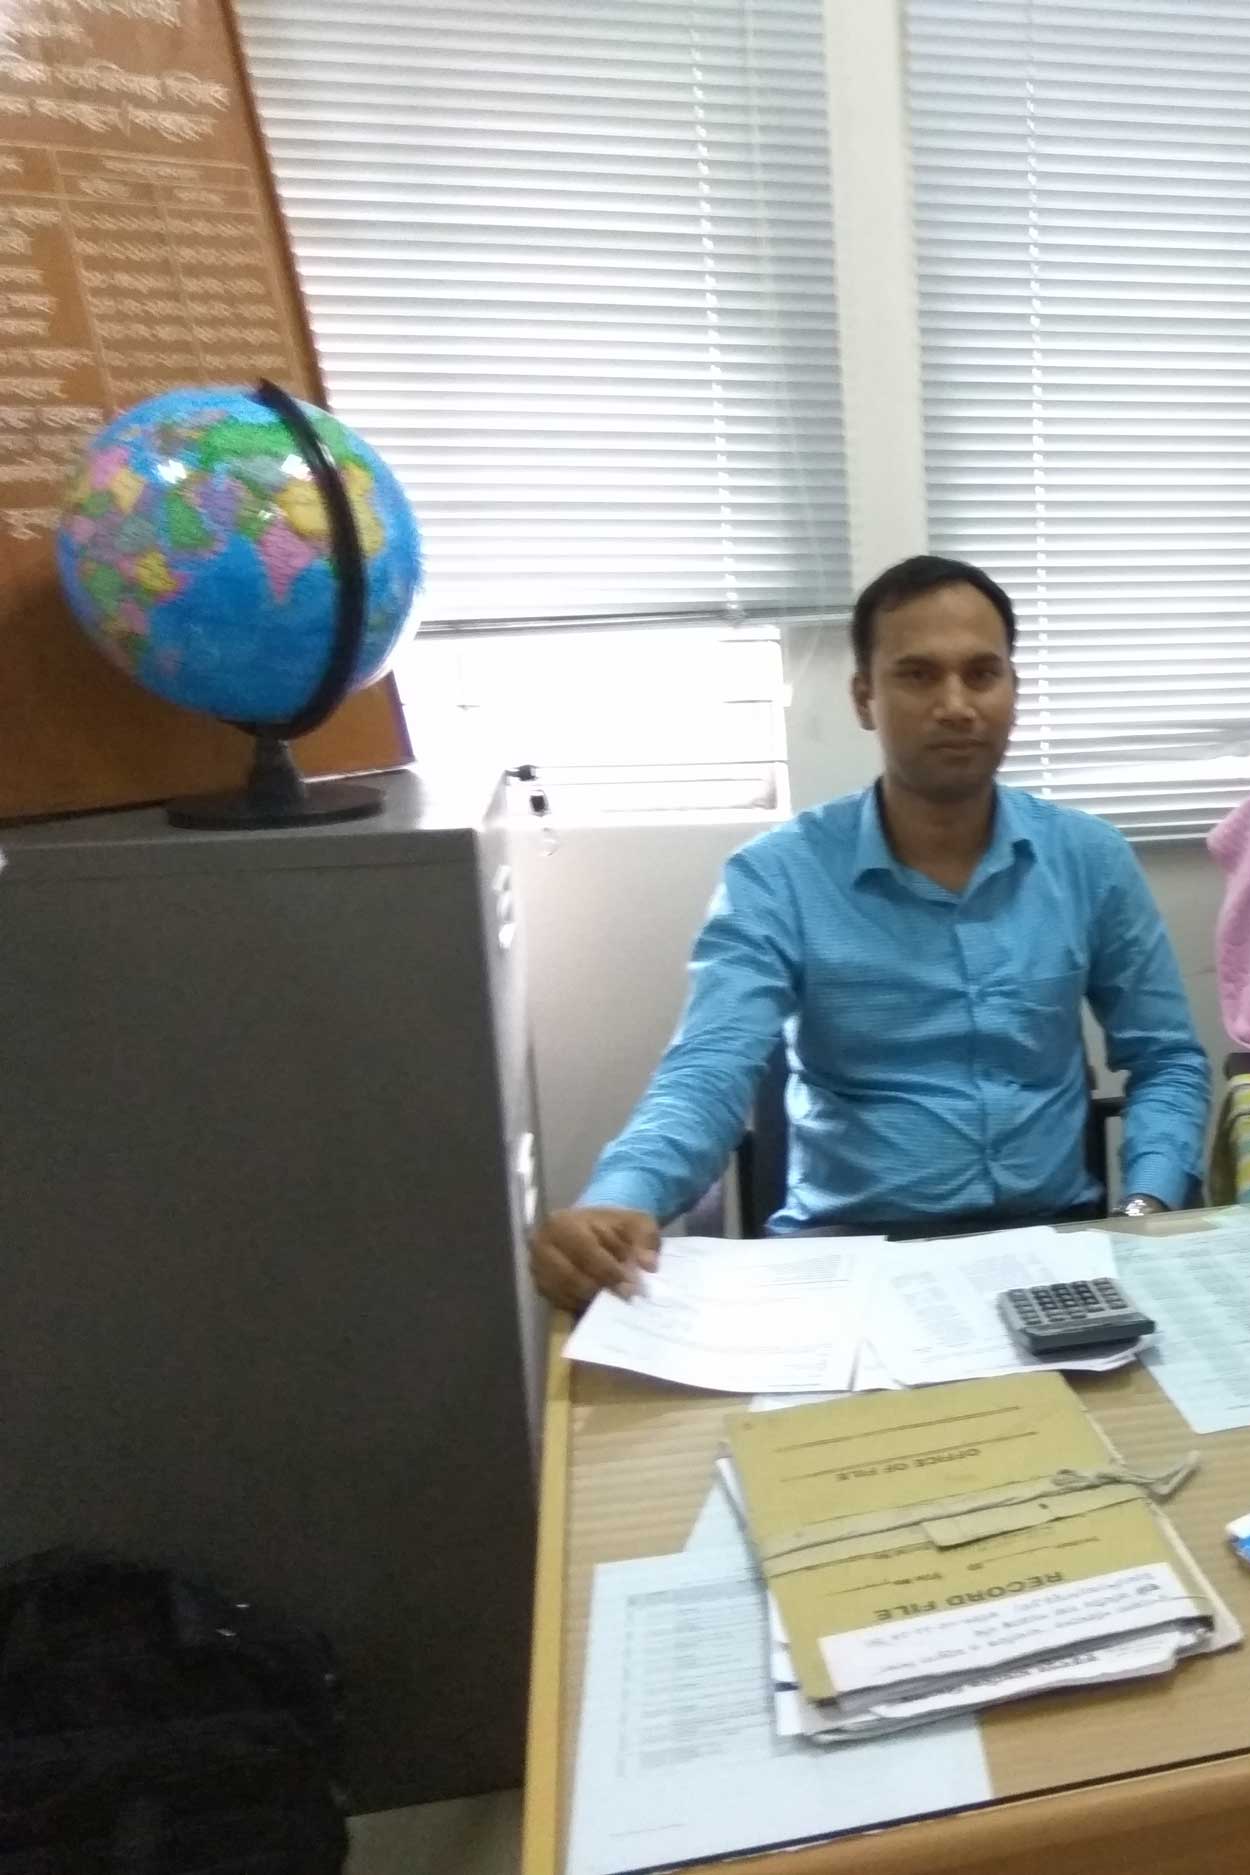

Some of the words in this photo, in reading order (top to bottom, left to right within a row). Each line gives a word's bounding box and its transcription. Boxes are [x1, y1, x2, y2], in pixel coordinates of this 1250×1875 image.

[883, 1462, 909, 1474] OF
[912, 1448, 981, 1468] OFFICE
[834, 1467, 880, 1482] FILE
[945, 1570, 1064, 1608] RECORD
[873, 1600, 937, 1622] FILE
